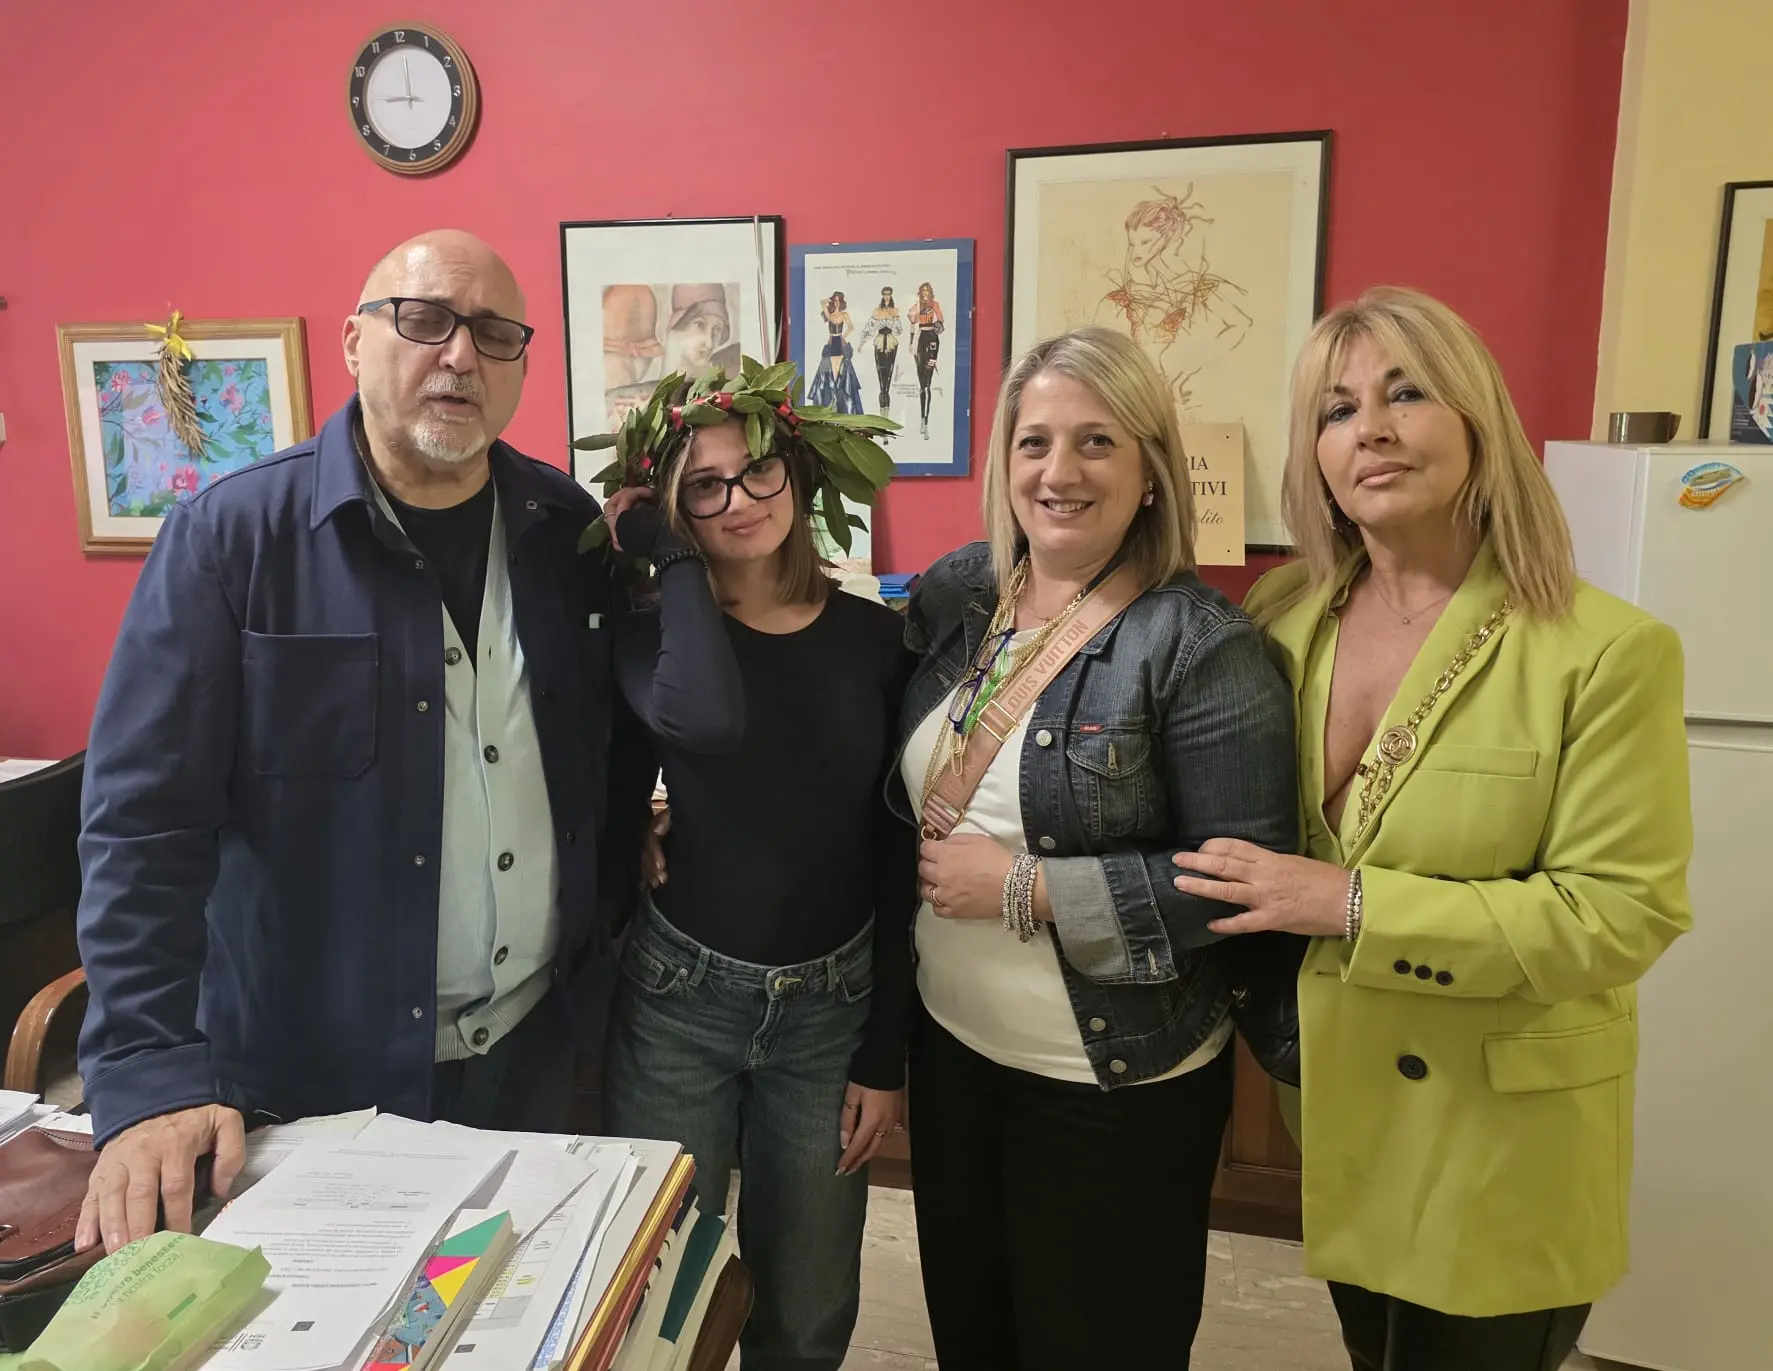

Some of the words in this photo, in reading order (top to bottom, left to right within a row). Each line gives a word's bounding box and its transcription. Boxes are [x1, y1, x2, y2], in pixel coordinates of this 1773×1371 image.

[395, 32, 405, 42] 12
[424, 36, 429, 47] 1
[372, 42, 379, 53] 11
[443, 56, 451, 68] 2
[355, 66, 366, 78] 10
[453, 85, 460, 97] 3
[352, 97, 360, 108] 9
[449, 116, 456, 127] 4
[362, 124, 371, 136] 8
[383, 144, 390, 156] 7
[433, 139, 441, 151] 5
[409, 149, 416, 161] 6
[1008, 676, 1037, 711] OUIS
[1034, 619, 1089, 675] VUITTON
